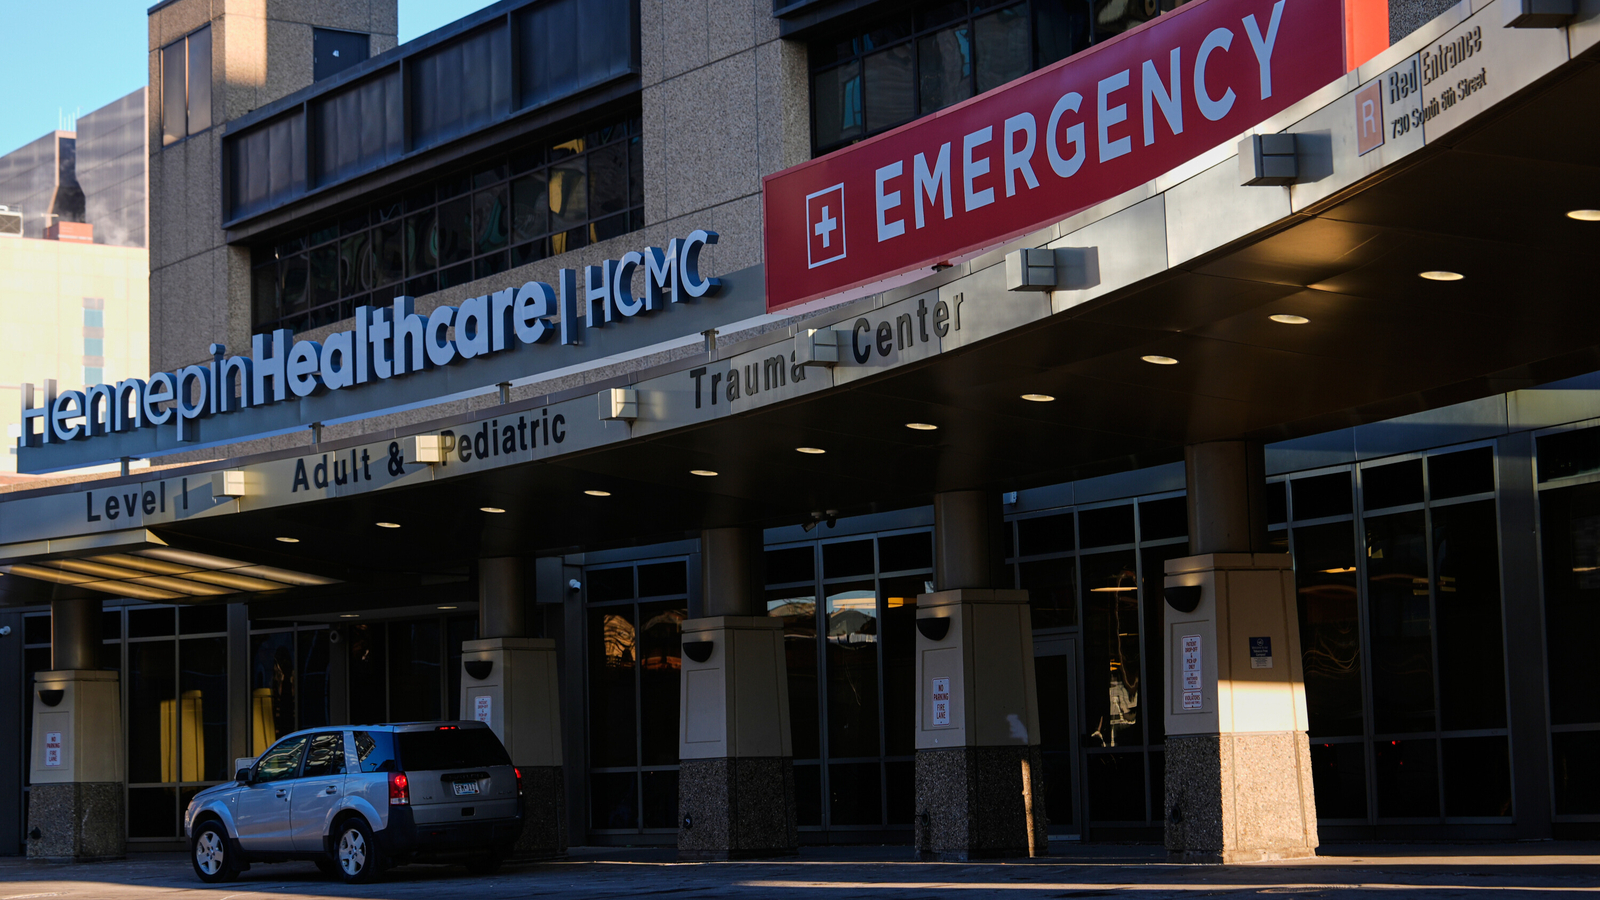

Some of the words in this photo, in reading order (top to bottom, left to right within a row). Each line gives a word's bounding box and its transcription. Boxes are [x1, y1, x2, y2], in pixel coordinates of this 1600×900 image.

[1388, 60, 1418, 105] Red
[1421, 25, 1483, 86] Entrance
[875, 0, 1285, 242] EMERGENCY
[1362, 99, 1377, 138] R
[1391, 113, 1410, 139] 730
[1411, 97, 1440, 129] South
[1457, 67, 1487, 101] Street
[585, 230, 720, 328] HCMC
[86, 480, 166, 522] Level
[292, 448, 371, 493] Adult
[387, 442, 405, 477] &
[441, 408, 566, 467] Pediatric
[689, 349, 806, 409] Trauma
[852, 292, 963, 365] Center
[933, 692, 949, 701] PARKING
[936, 703, 945, 711] FIRE
[936, 711, 946, 719] LANE
[938, 684, 944, 692] NO
